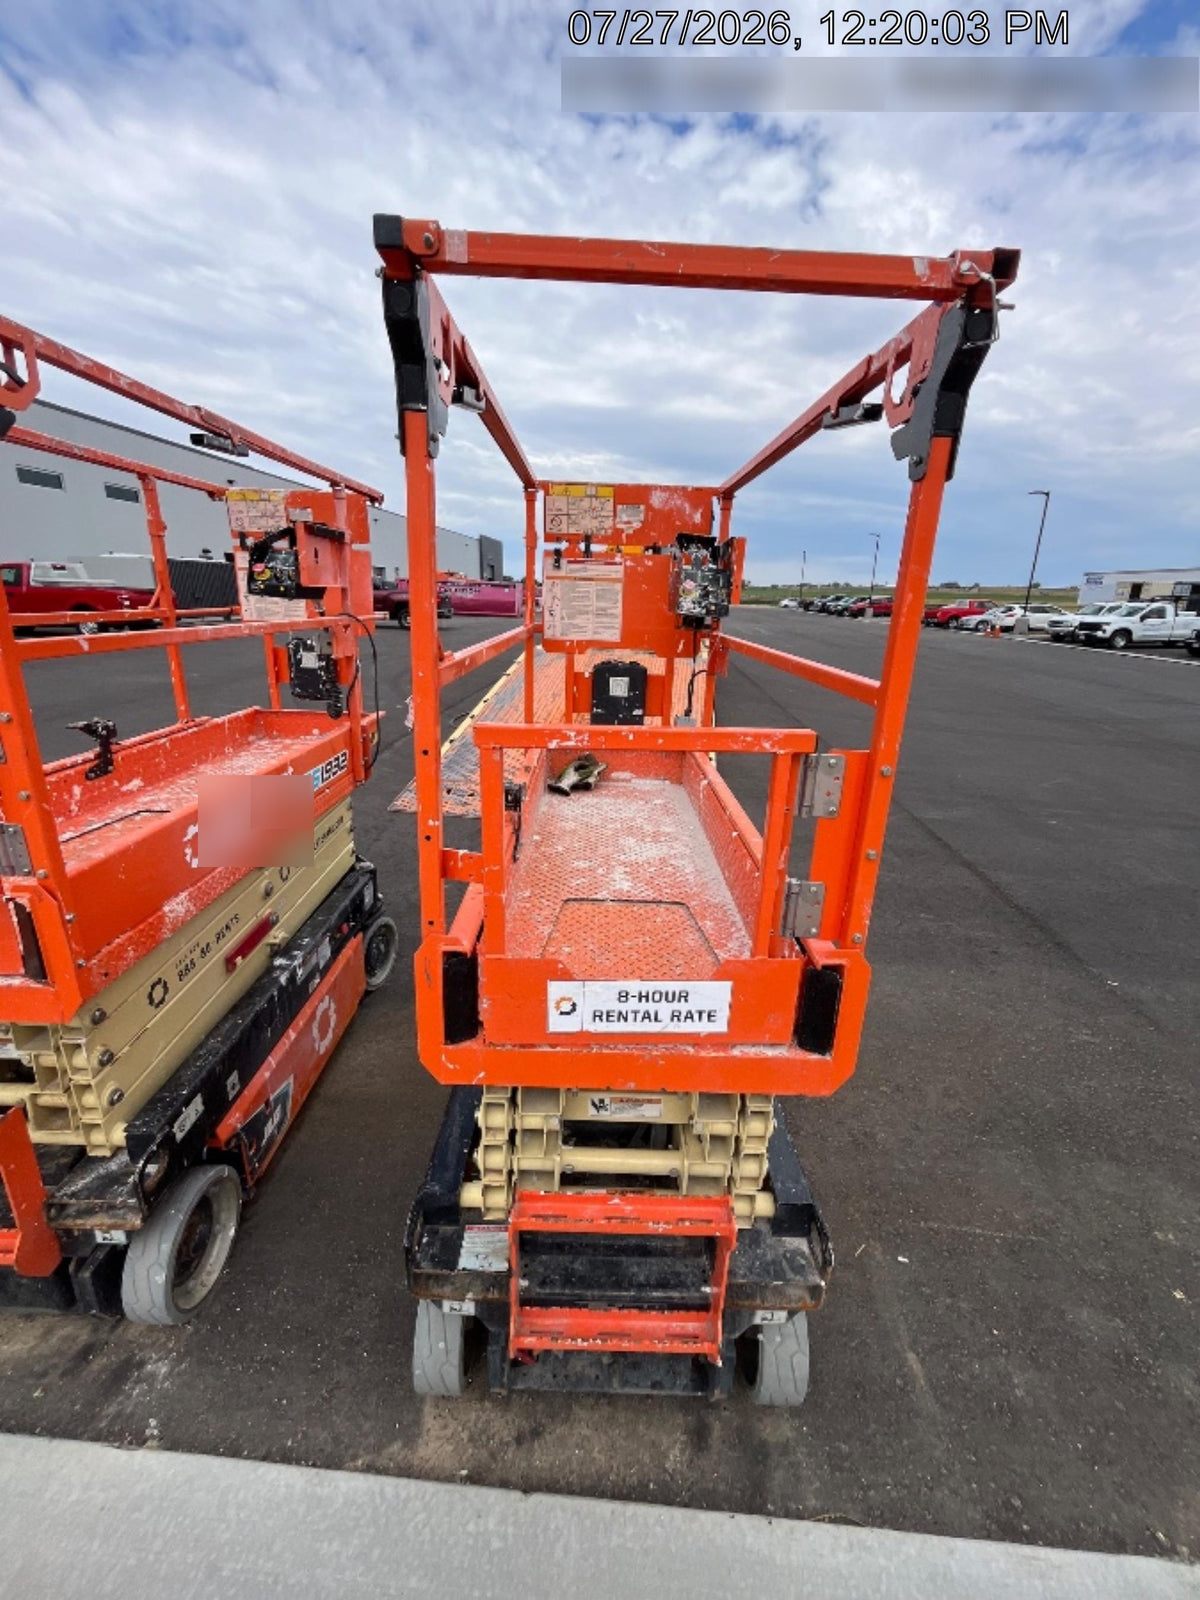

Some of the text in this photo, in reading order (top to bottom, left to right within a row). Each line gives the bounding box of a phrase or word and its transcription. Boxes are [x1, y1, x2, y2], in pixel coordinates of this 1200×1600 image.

[617, 990, 690, 1004] 8-HOUR
[592, 1009, 717, 1023] RENTAL RATE
